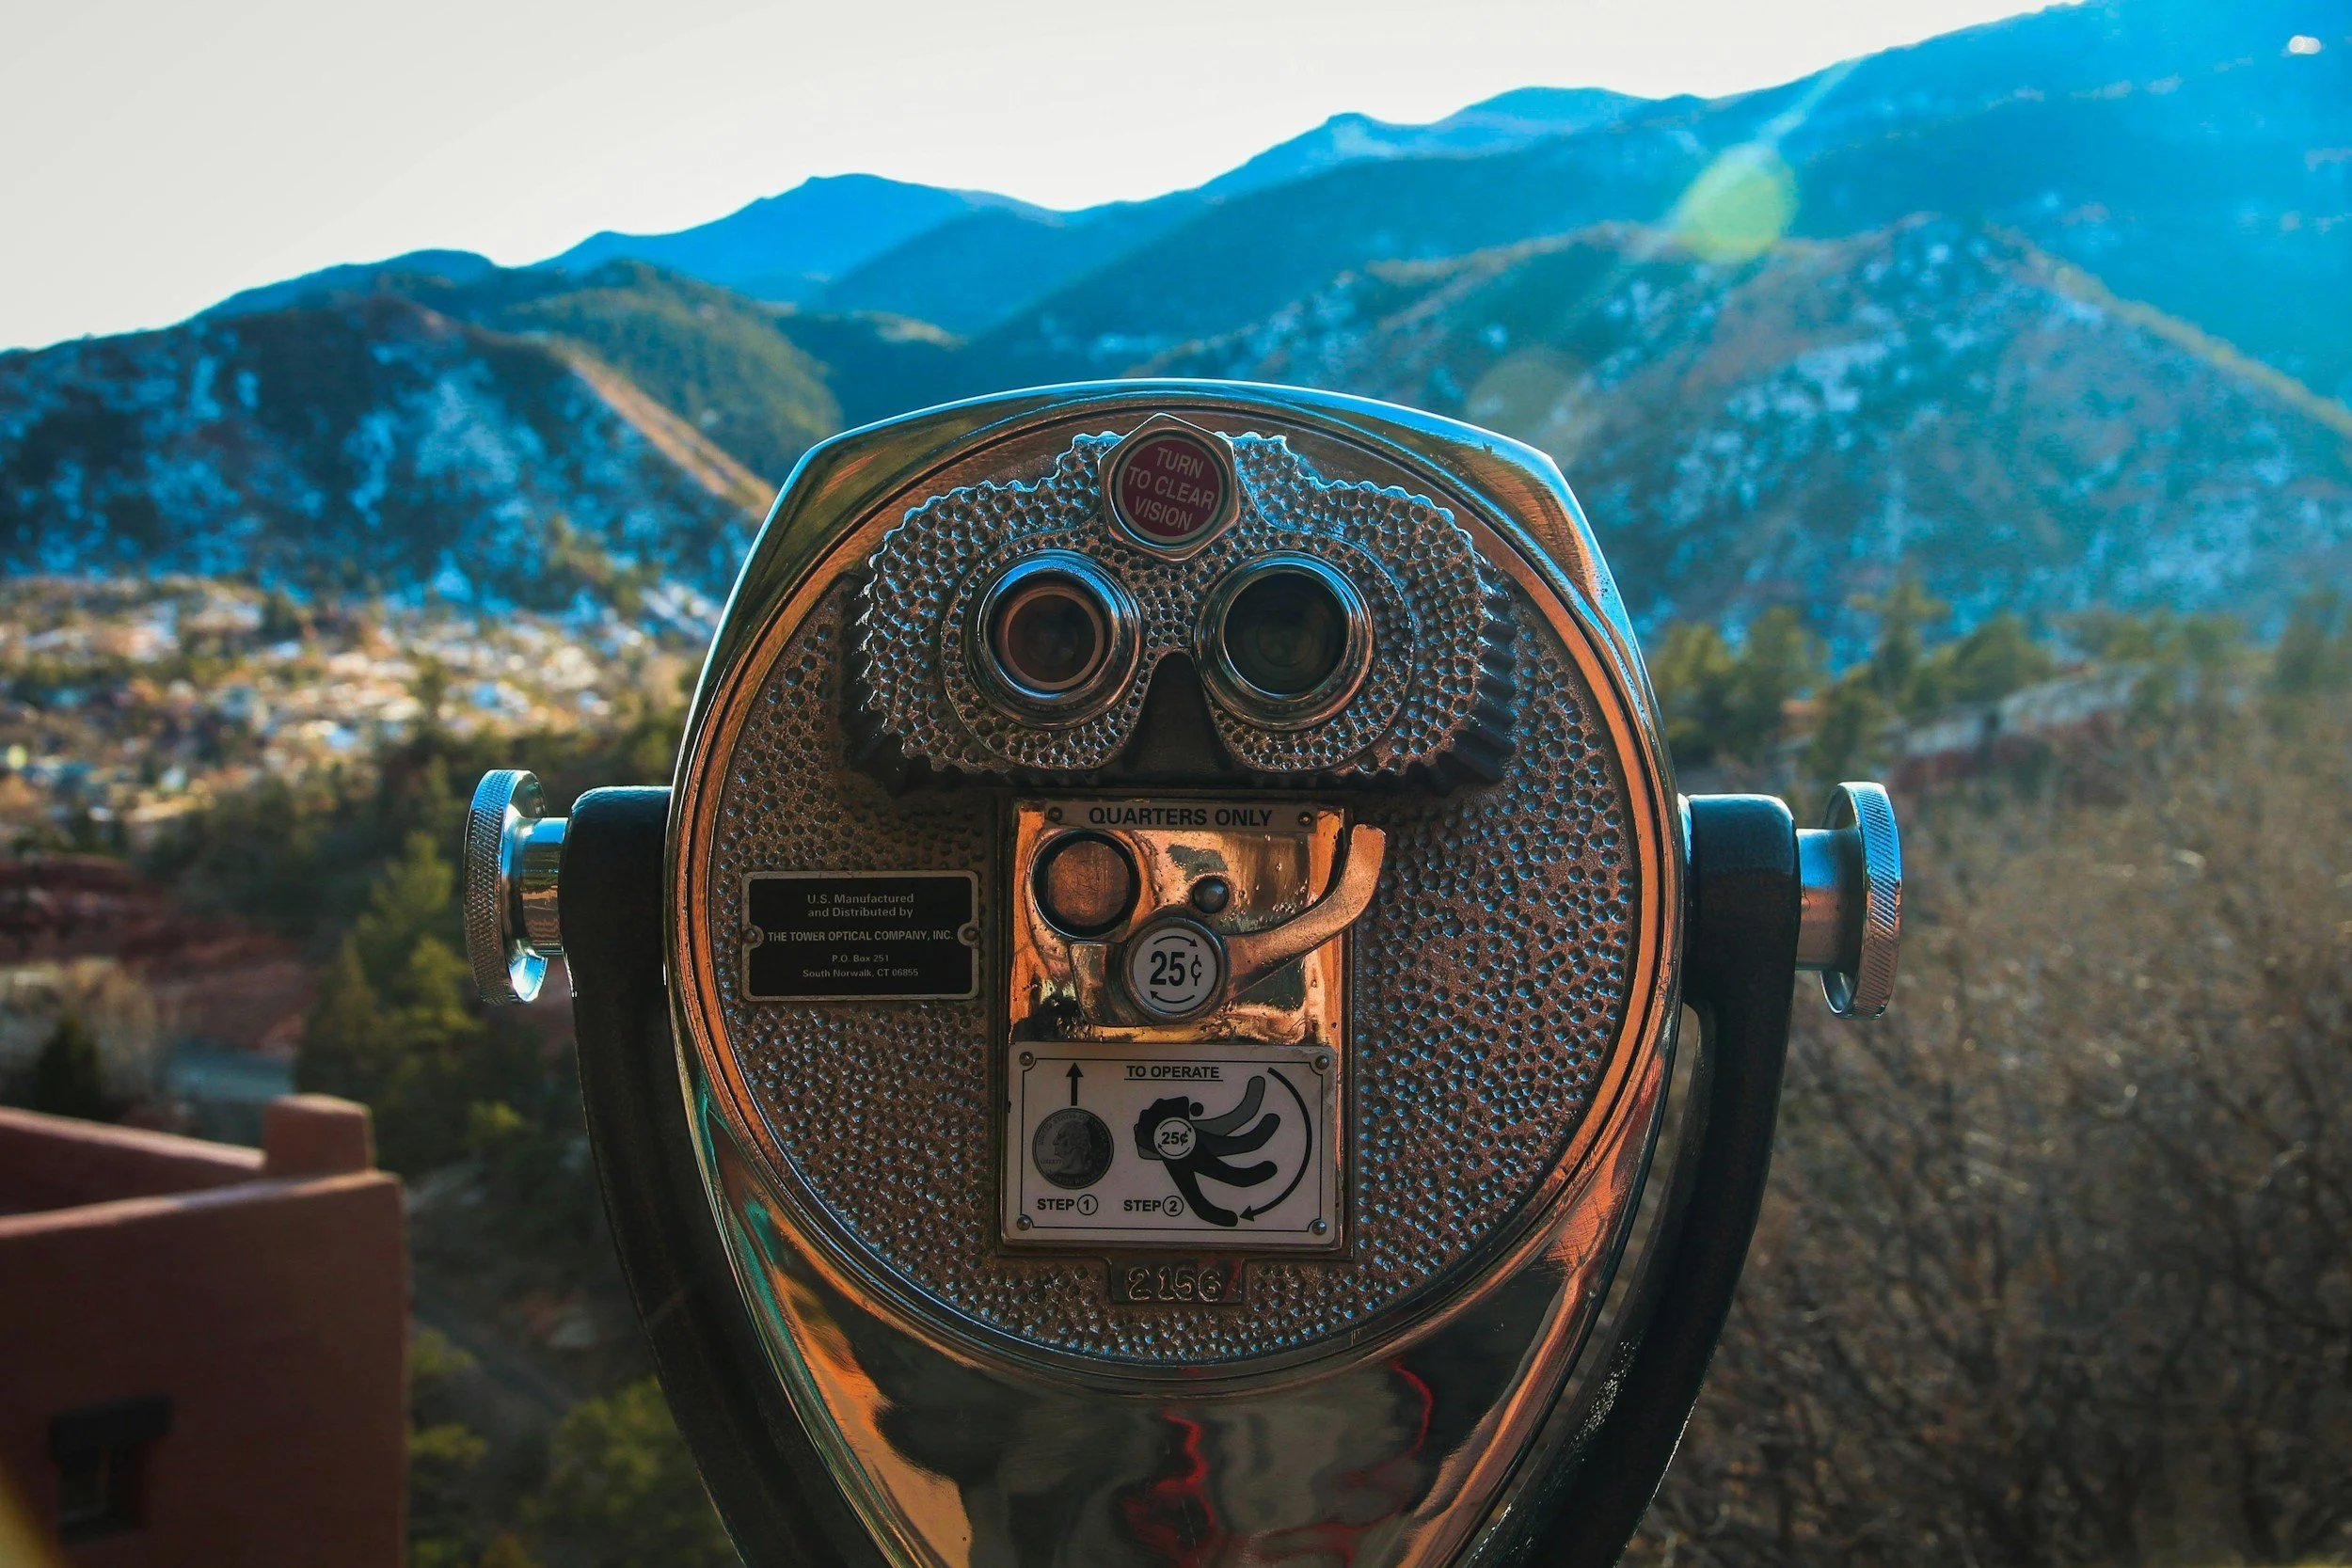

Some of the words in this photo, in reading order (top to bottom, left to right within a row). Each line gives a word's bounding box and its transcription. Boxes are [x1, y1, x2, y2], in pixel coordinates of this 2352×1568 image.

[1156, 447, 1203, 478] TURN
[1129, 467, 1151, 489] TO
[1154, 476, 1215, 510] CLEAR
[1135, 496, 1192, 531] VISION
[1089, 807, 1207, 826] QUARTERS
[1215, 809, 1272, 826] ONLY
[807, 895, 831, 904] U.S.
[834, 894, 914, 904] Manufactured
[807, 908, 829, 917] and
[833, 907, 896, 917] Distributed
[898, 907, 914, 918] by
[768, 931, 787, 942] THE
[790, 931, 825, 942] TOWER
[828, 931, 871, 941] OPTICAL
[874, 930, 930, 942] COMPANY,
[932, 930, 954, 940] INC.
[853, 954, 870, 963] Box
[873, 954, 889, 962] 251
[803, 969, 831, 978] South
[833, 969, 875, 978] Norwalk,
[877, 968, 889, 977] CT
[892, 968, 919, 977] 06855
[1127, 1066, 1146, 1078] TO
[1151, 1066, 1220, 1079] OPERATE
[1037, 1198, 1074, 1211] STEP
[1123, 1200, 1161, 1212] STEP
[1129, 1266, 1222, 1303] 2156
